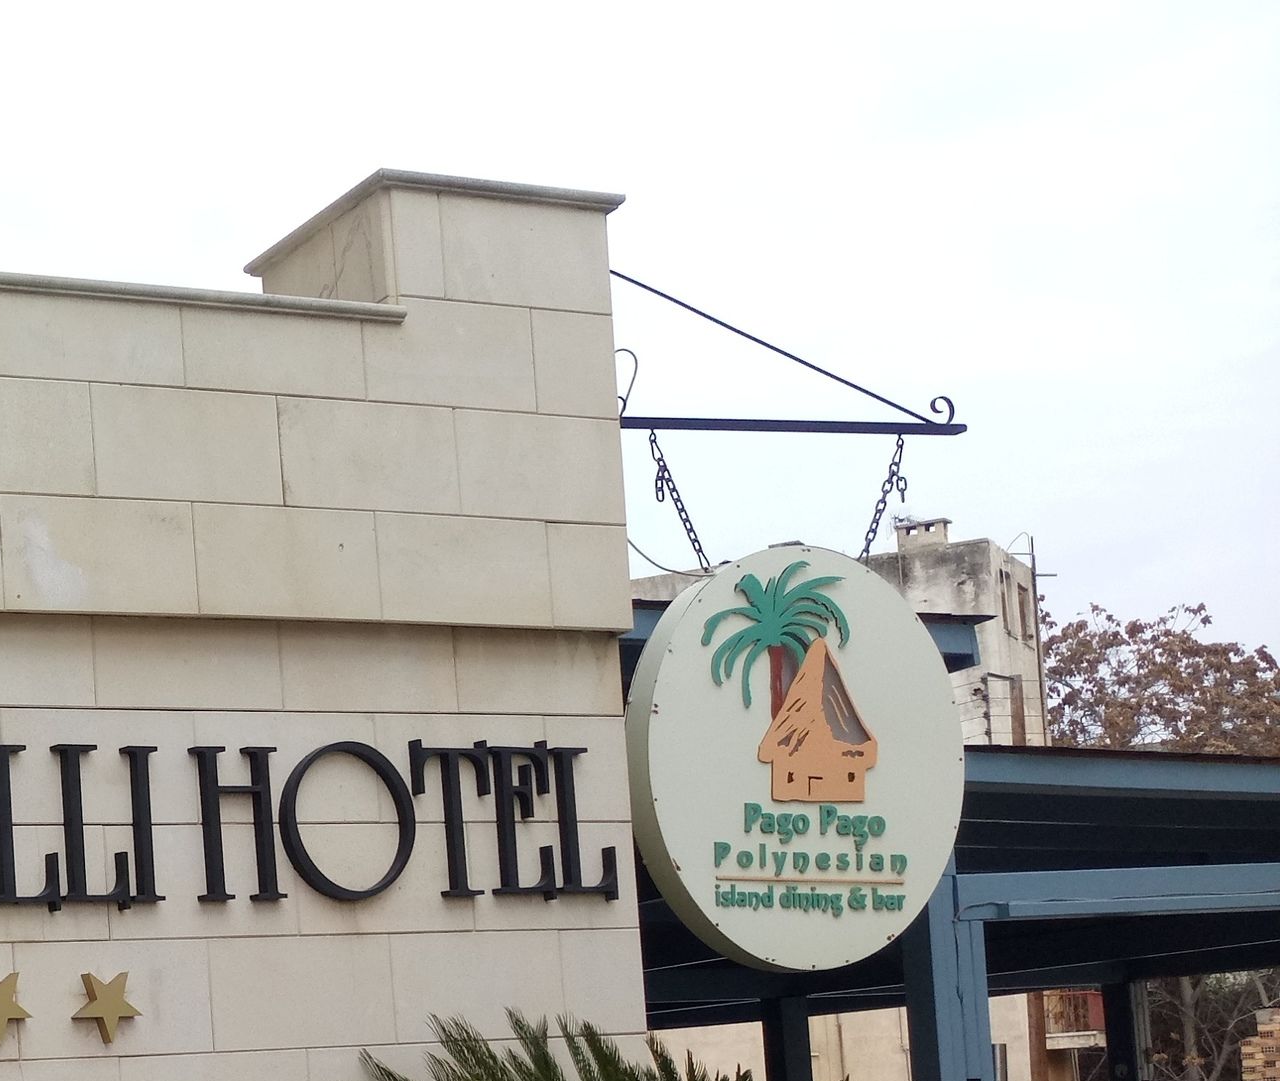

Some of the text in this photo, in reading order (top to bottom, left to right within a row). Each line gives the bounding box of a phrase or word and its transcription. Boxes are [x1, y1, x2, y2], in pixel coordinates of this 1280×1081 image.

[187, 737, 619, 904] HOTEL
[744, 802, 886, 849] Pago Pago
[713, 841, 908, 876] Polynesian
[714, 884, 906, 917] island dining & bar
